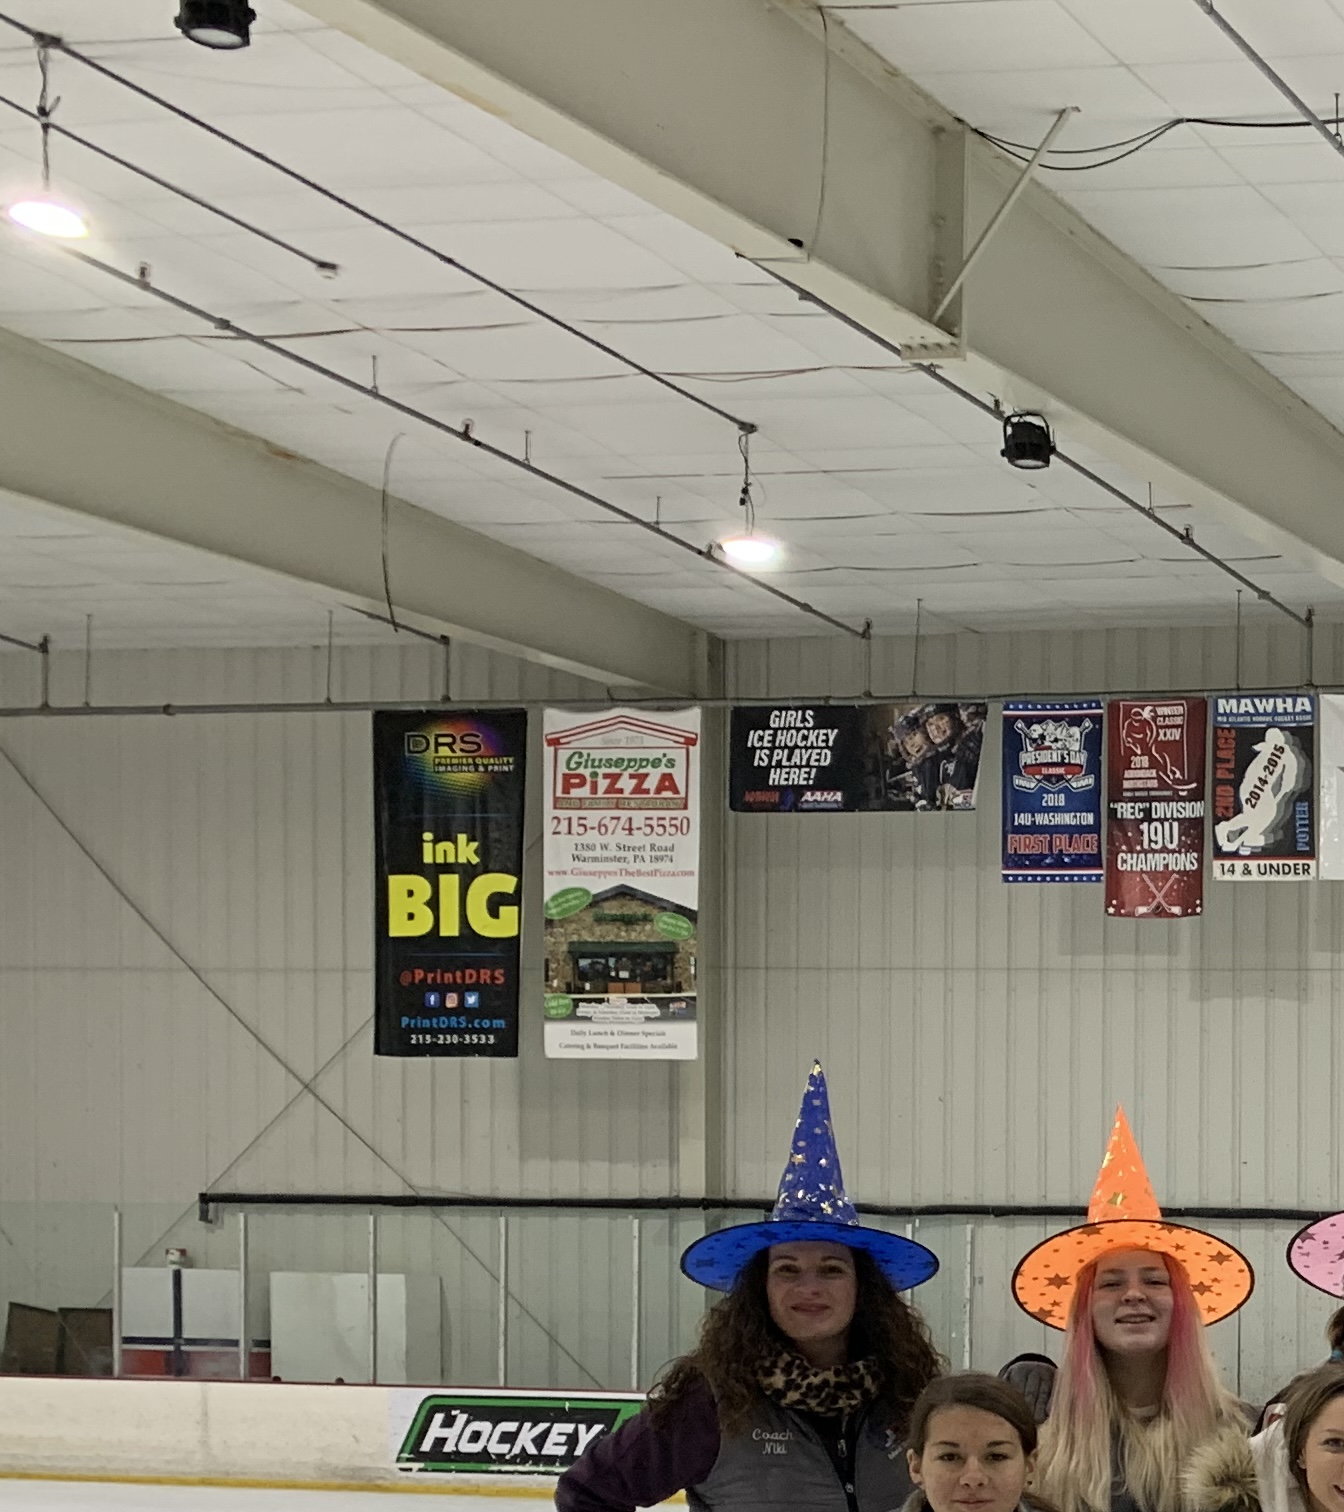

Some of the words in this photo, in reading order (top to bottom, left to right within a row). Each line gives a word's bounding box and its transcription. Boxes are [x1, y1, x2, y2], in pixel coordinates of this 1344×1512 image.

[1217, 697, 1313, 714] MAWHA
[769, 710, 814, 729] GIRLS
[405, 732, 483, 756] DRS
[747, 730, 773, 749] ICE
[775, 729, 838, 748] HOCKEY
[1157, 728, 1182, 741] XXIV
[434, 757, 474, 765] PREMIER
[475, 757, 514, 765] QUALITY
[565, 751, 676, 771] Giuseppe's
[753, 749, 770, 767] IS
[771, 748, 831, 767] PLAYED
[1021, 750, 1070, 766] PRESIDENT'S
[1070, 750, 1086, 765] DAY
[1216, 728, 1236, 779] PLACE
[768, 767, 817, 786] HERE!
[1244, 743, 1285, 809] 2014-2015
[1041, 793, 1066, 807] 2018
[1151, 800, 1205, 819] DIVISION
[1215, 784, 1235, 819] 2ND
[551, 816, 691, 837] 215-674-5550
[1013, 812, 1094, 826] 14U-WASHINGTON
[1295, 801, 1310, 852] POTTER
[1007, 834, 1050, 854] FIRST
[1052, 834, 1098, 854] PLACE
[1139, 821, 1179, 850] 19U
[422, 832, 480, 864] ink
[616, 843, 647, 852] Street
[650, 843, 675, 852] Road
[571, 854, 631, 865] Warminster,
[633, 855, 646, 863] PA
[1116, 852, 1199, 871] CHAMPIONS
[1219, 863, 1236, 876] 14
[1242, 863, 1253, 876] &
[1257, 862, 1311, 876] UNDER
[388, 873, 519, 938] BIG
[400, 968, 505, 987] @PrintDRS
[401, 1016, 506, 1029] PrintDRS.com
[419, 1412, 606, 1457] HOCKEY
[752, 1428, 794, 1441] Coach
